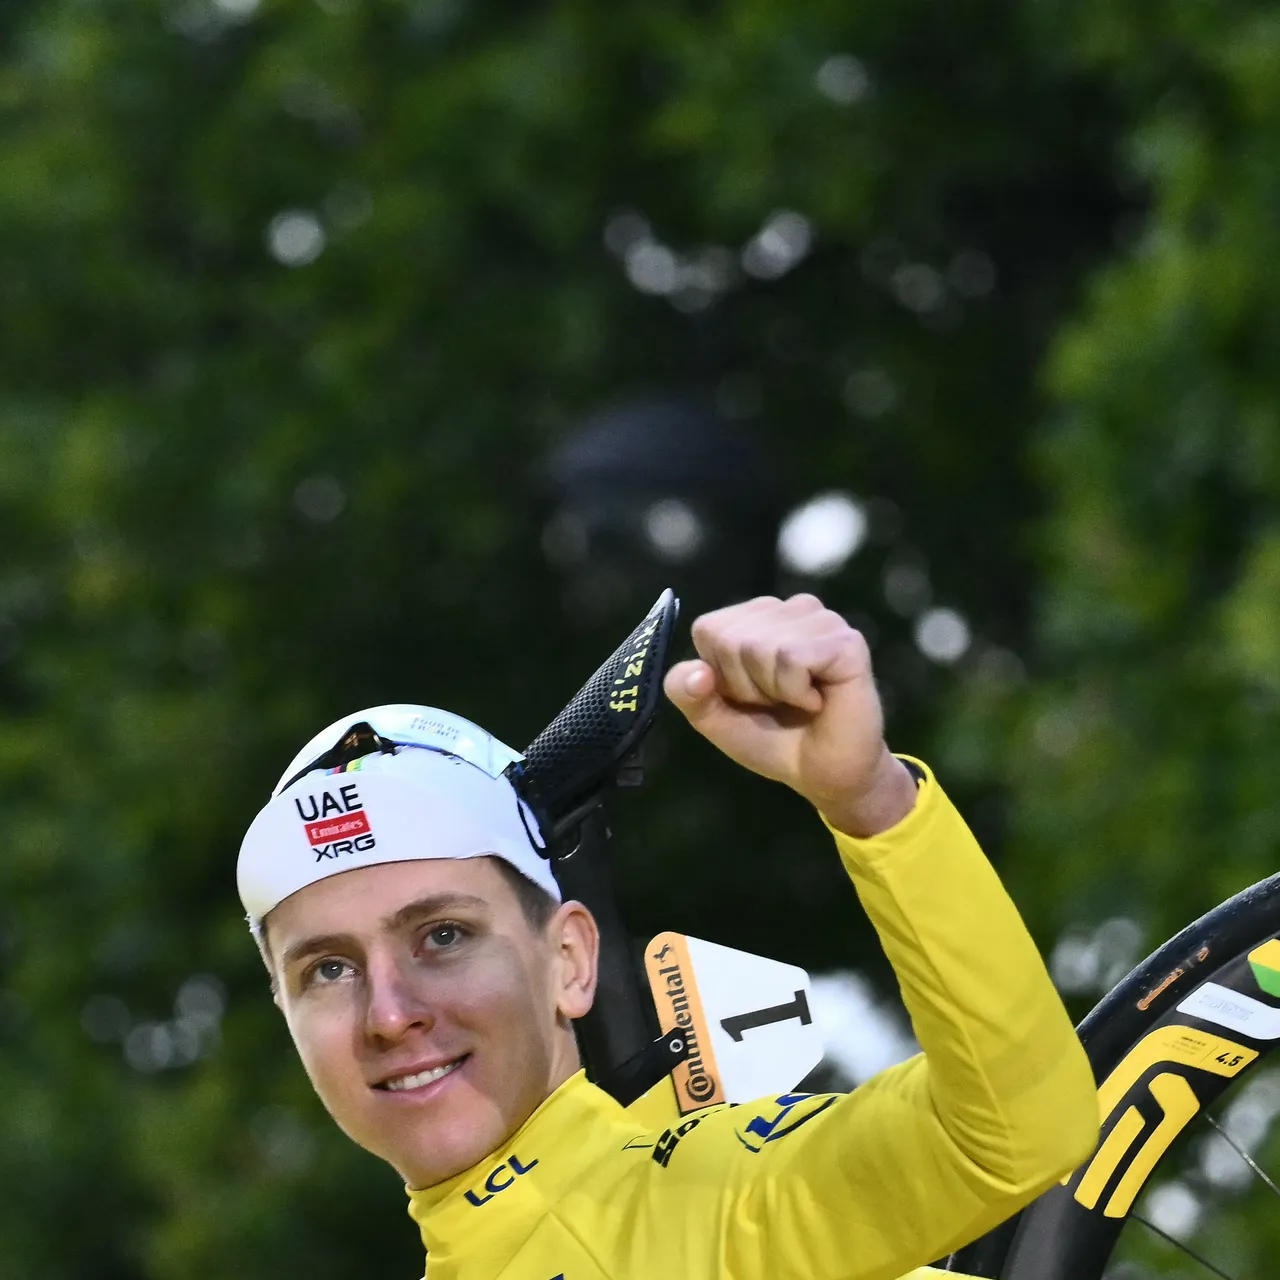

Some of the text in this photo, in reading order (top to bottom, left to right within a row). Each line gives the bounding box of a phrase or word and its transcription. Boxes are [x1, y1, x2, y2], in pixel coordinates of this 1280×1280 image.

[295, 784, 363, 821] UAE
[310, 817, 364, 840] Emirates
[312, 834, 376, 863] XRG
[720, 989, 813, 1043] 1
[1214, 1052, 1245, 1067] 4.5
[463, 1153, 539, 1208] LCL
